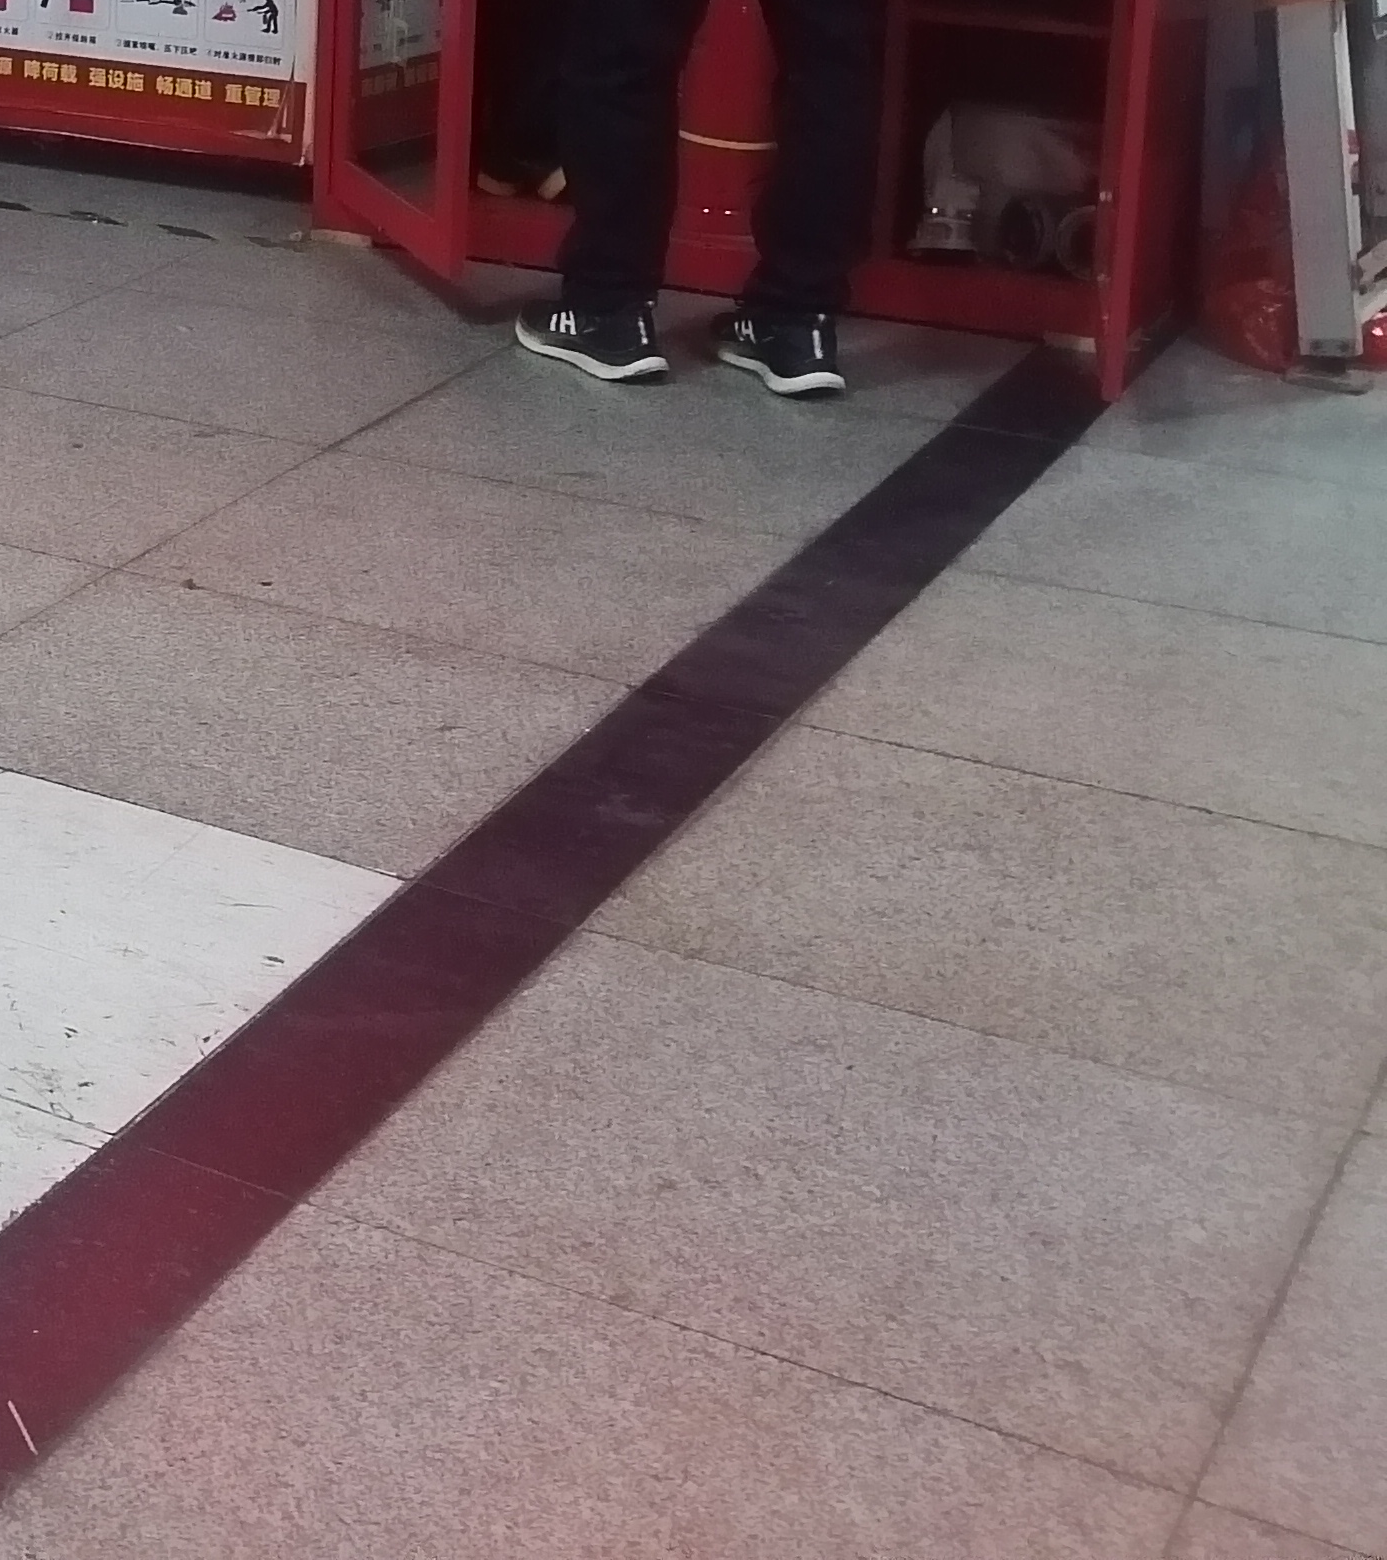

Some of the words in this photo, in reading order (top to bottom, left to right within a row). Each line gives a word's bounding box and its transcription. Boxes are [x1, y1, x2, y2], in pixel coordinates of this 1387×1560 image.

[23, 59, 78, 84] 降荷载
[88, 67, 144, 93] 强设施
[155, 75, 213, 101] 畅通道
[224, 83, 282, 109] 重管理
